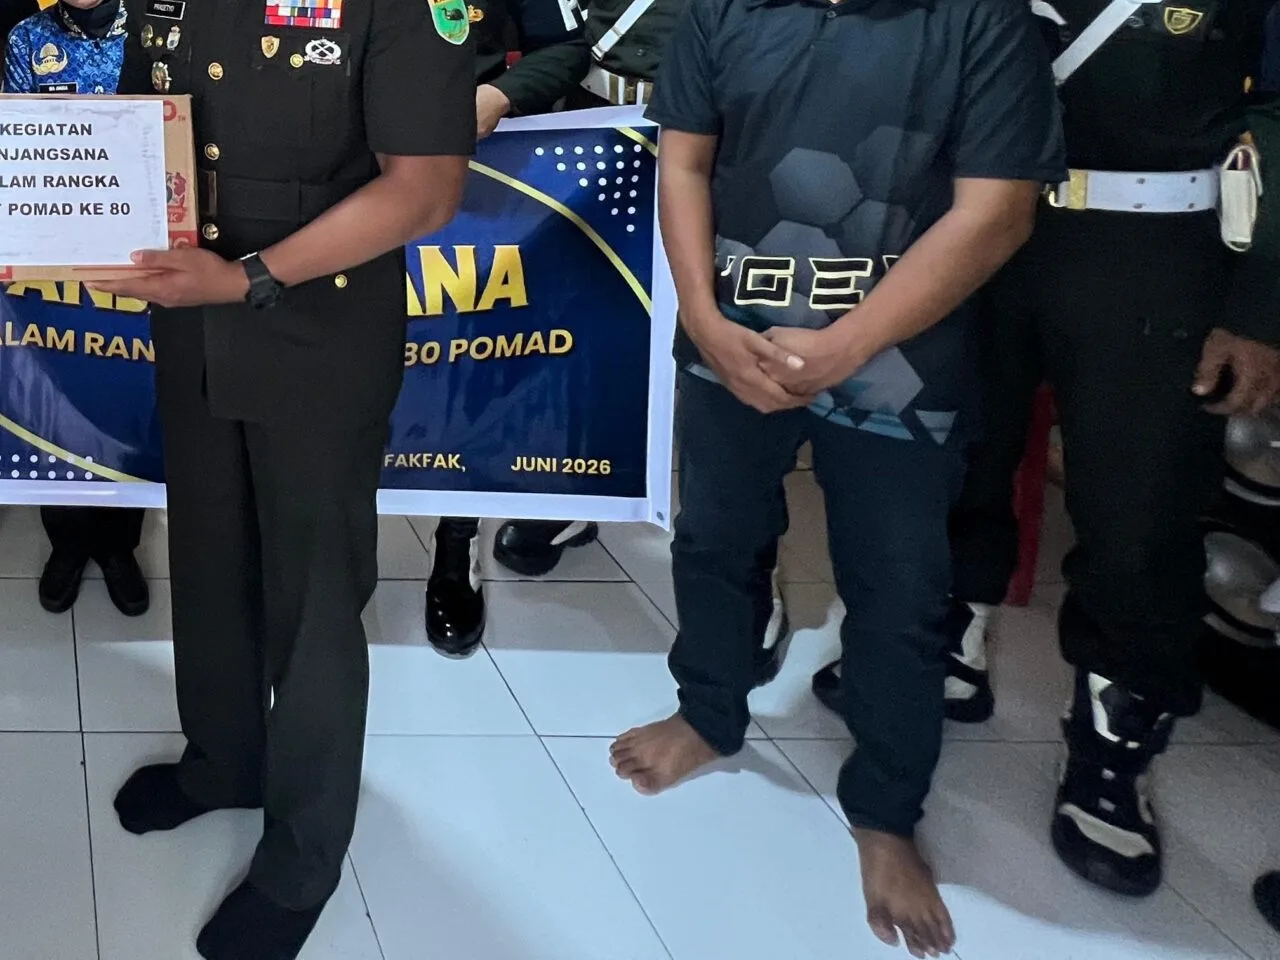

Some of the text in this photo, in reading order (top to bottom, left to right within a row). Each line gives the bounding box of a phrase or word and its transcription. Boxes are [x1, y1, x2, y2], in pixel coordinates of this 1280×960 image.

[0, 123, 93, 136] KEGIATAN
[43, 174, 120, 188] RANGKA
[8, 203, 73, 216] POMAD
[79, 203, 103, 215] KE
[109, 202, 131, 215] 80
[448, 329, 573, 363] POMAD
[384, 453, 611, 475] FAKFAK, JUNI 2026
